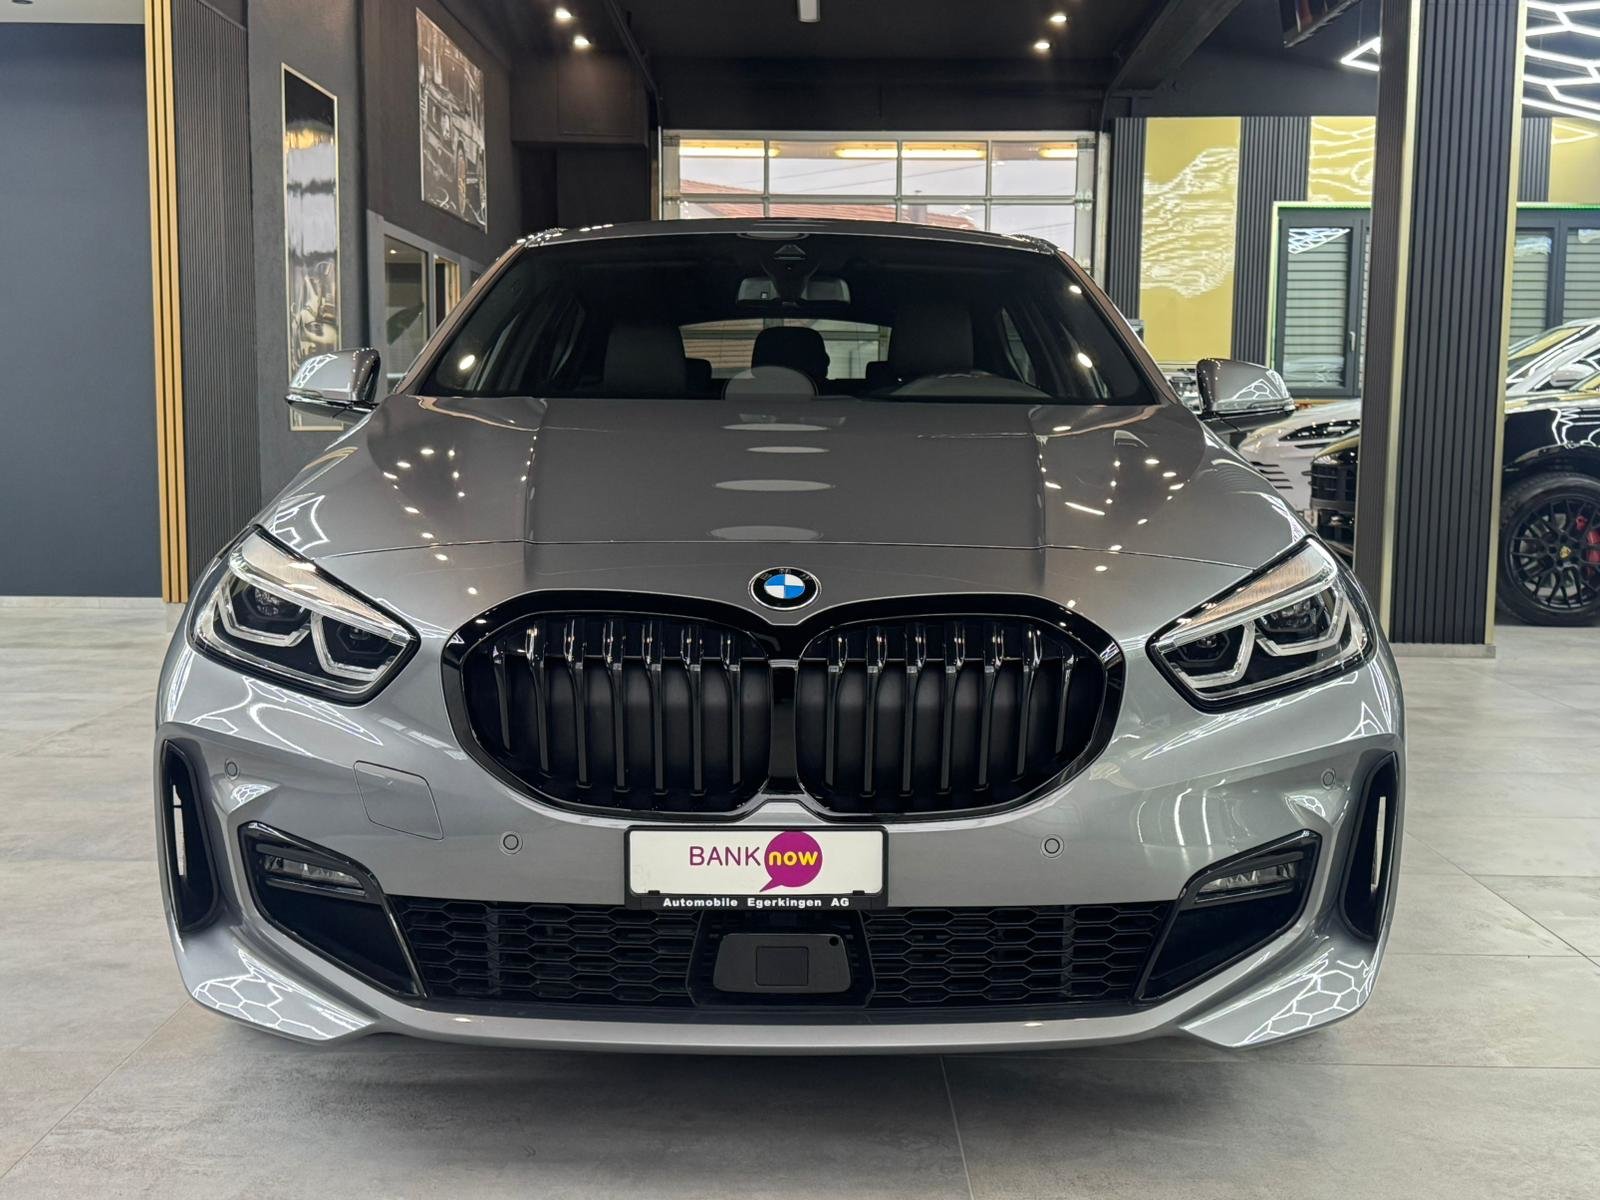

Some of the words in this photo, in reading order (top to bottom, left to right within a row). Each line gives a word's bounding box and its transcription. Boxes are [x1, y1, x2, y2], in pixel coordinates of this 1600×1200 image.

[689, 846, 761, 866] BANK
[768, 851, 818, 866] now
[663, 898, 738, 907] Automobile
[747, 898, 822, 908] Egerkingen
[831, 898, 850, 907] AG
